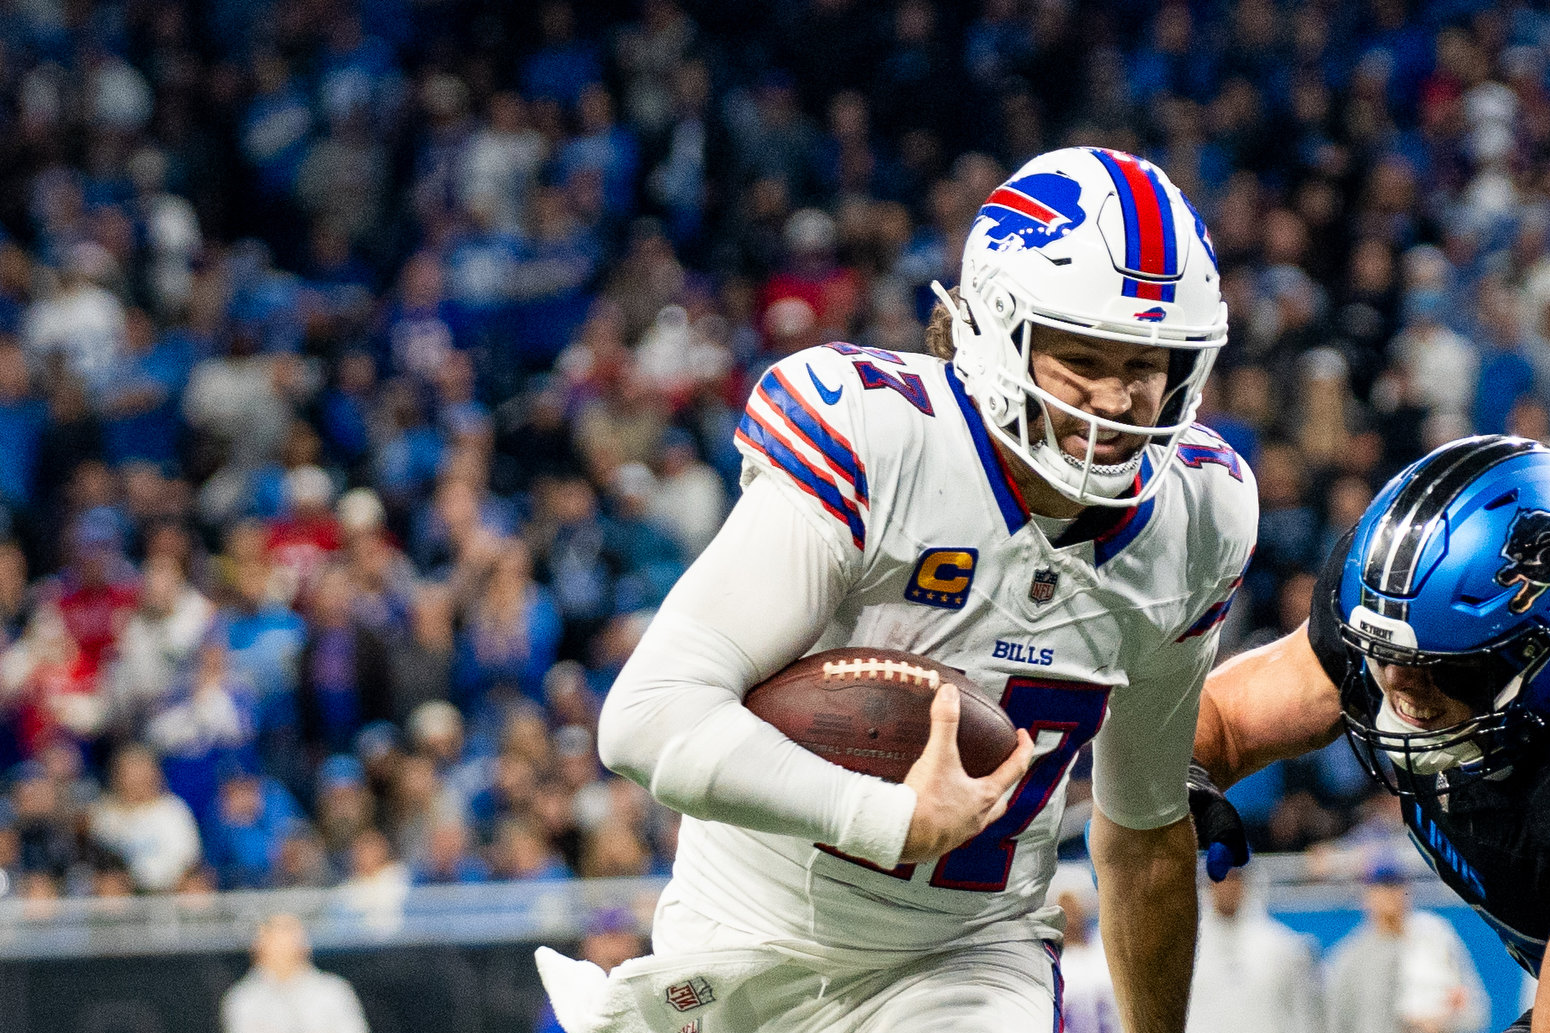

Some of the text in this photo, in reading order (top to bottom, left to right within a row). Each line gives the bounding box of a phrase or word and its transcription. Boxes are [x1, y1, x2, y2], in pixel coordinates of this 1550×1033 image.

[917, 551, 974, 594] C
[1360, 619, 1394, 640] DETROIT
[992, 639, 1054, 666] BILLS
